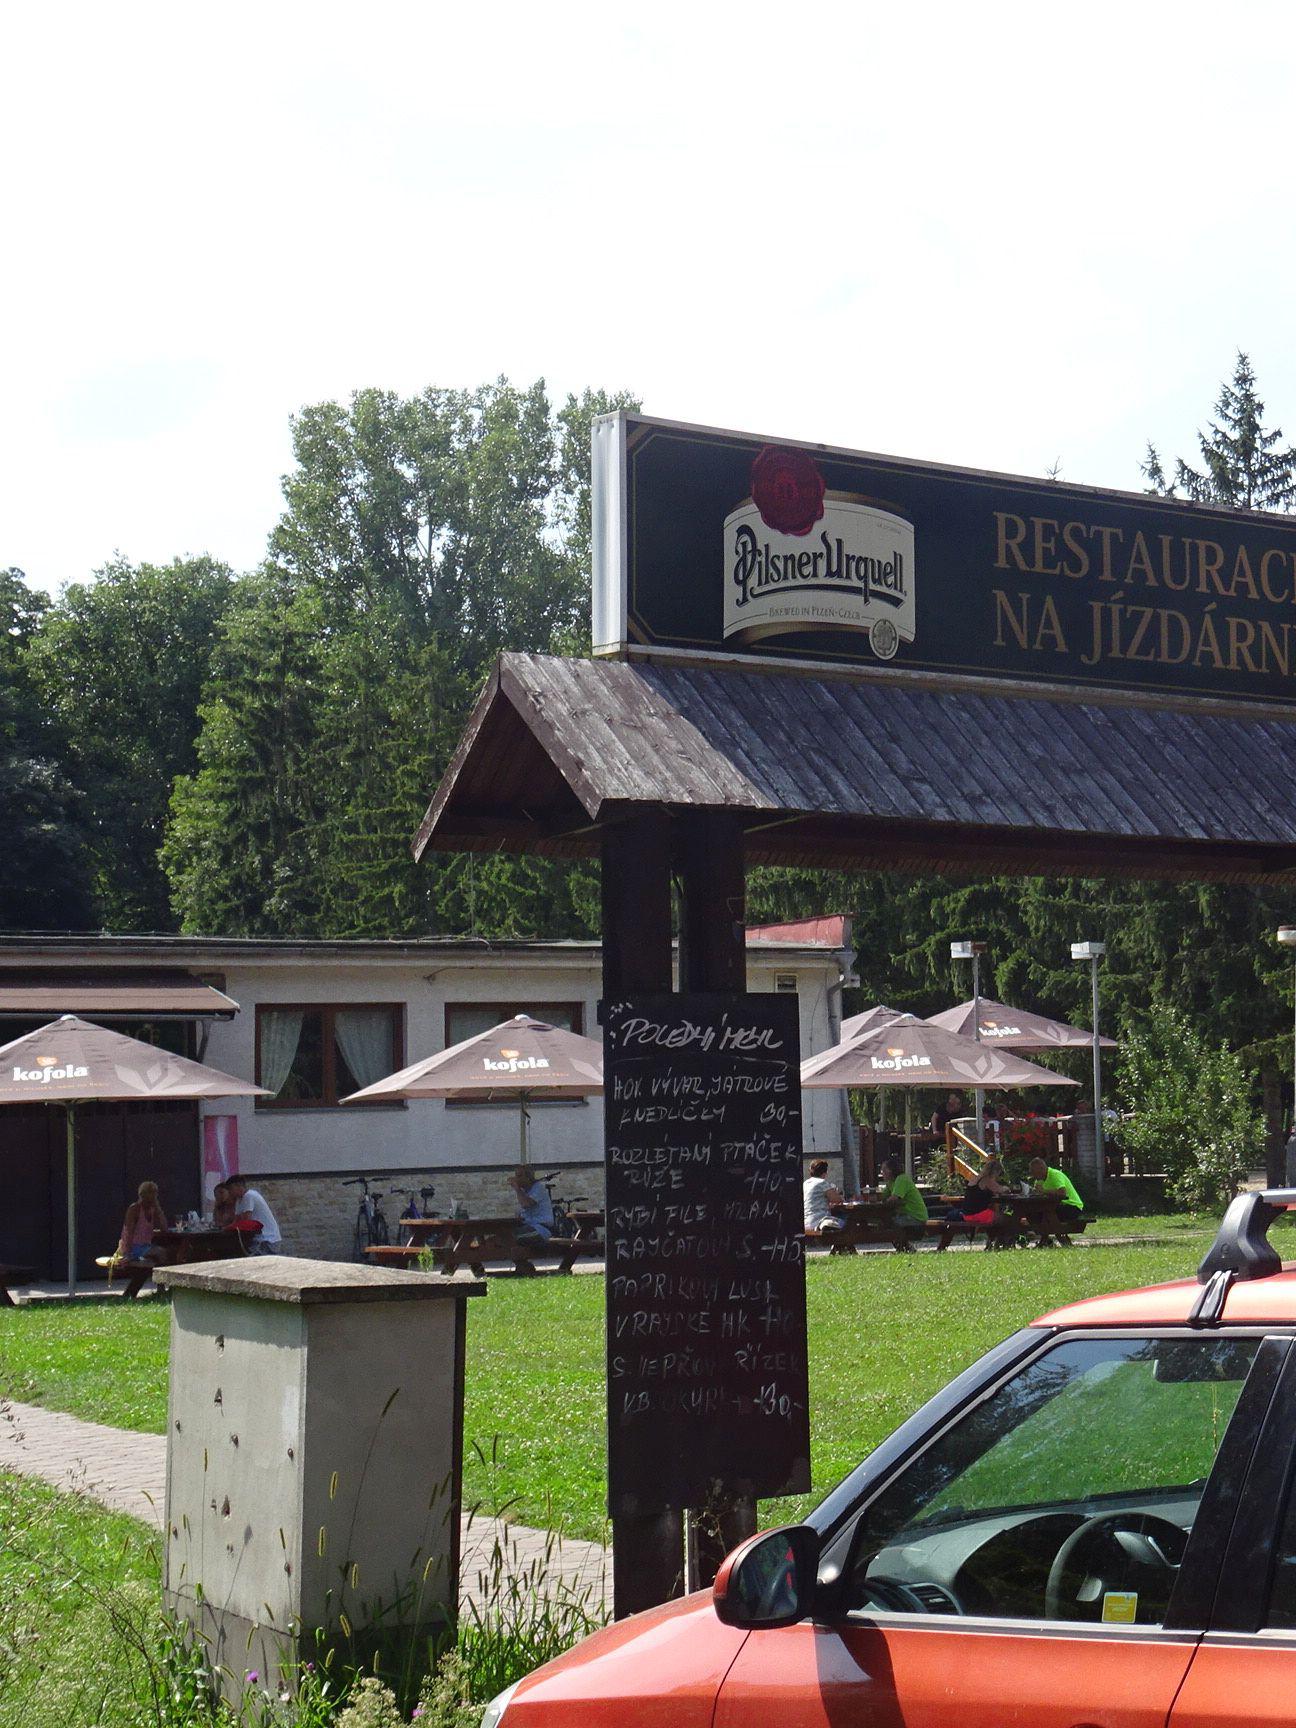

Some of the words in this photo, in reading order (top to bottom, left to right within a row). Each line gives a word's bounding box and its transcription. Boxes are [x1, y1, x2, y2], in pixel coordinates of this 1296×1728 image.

[734, 524, 824, 607] Pilsner
[820, 530, 904, 606] Urquell
[992, 589, 1069, 653] NA
[979, 1026, 1022, 1038] kofola
[483, 1056, 550, 1072] kofola
[871, 1055, 931, 1071] kofola
[13, 1064, 89, 1084] kofola
